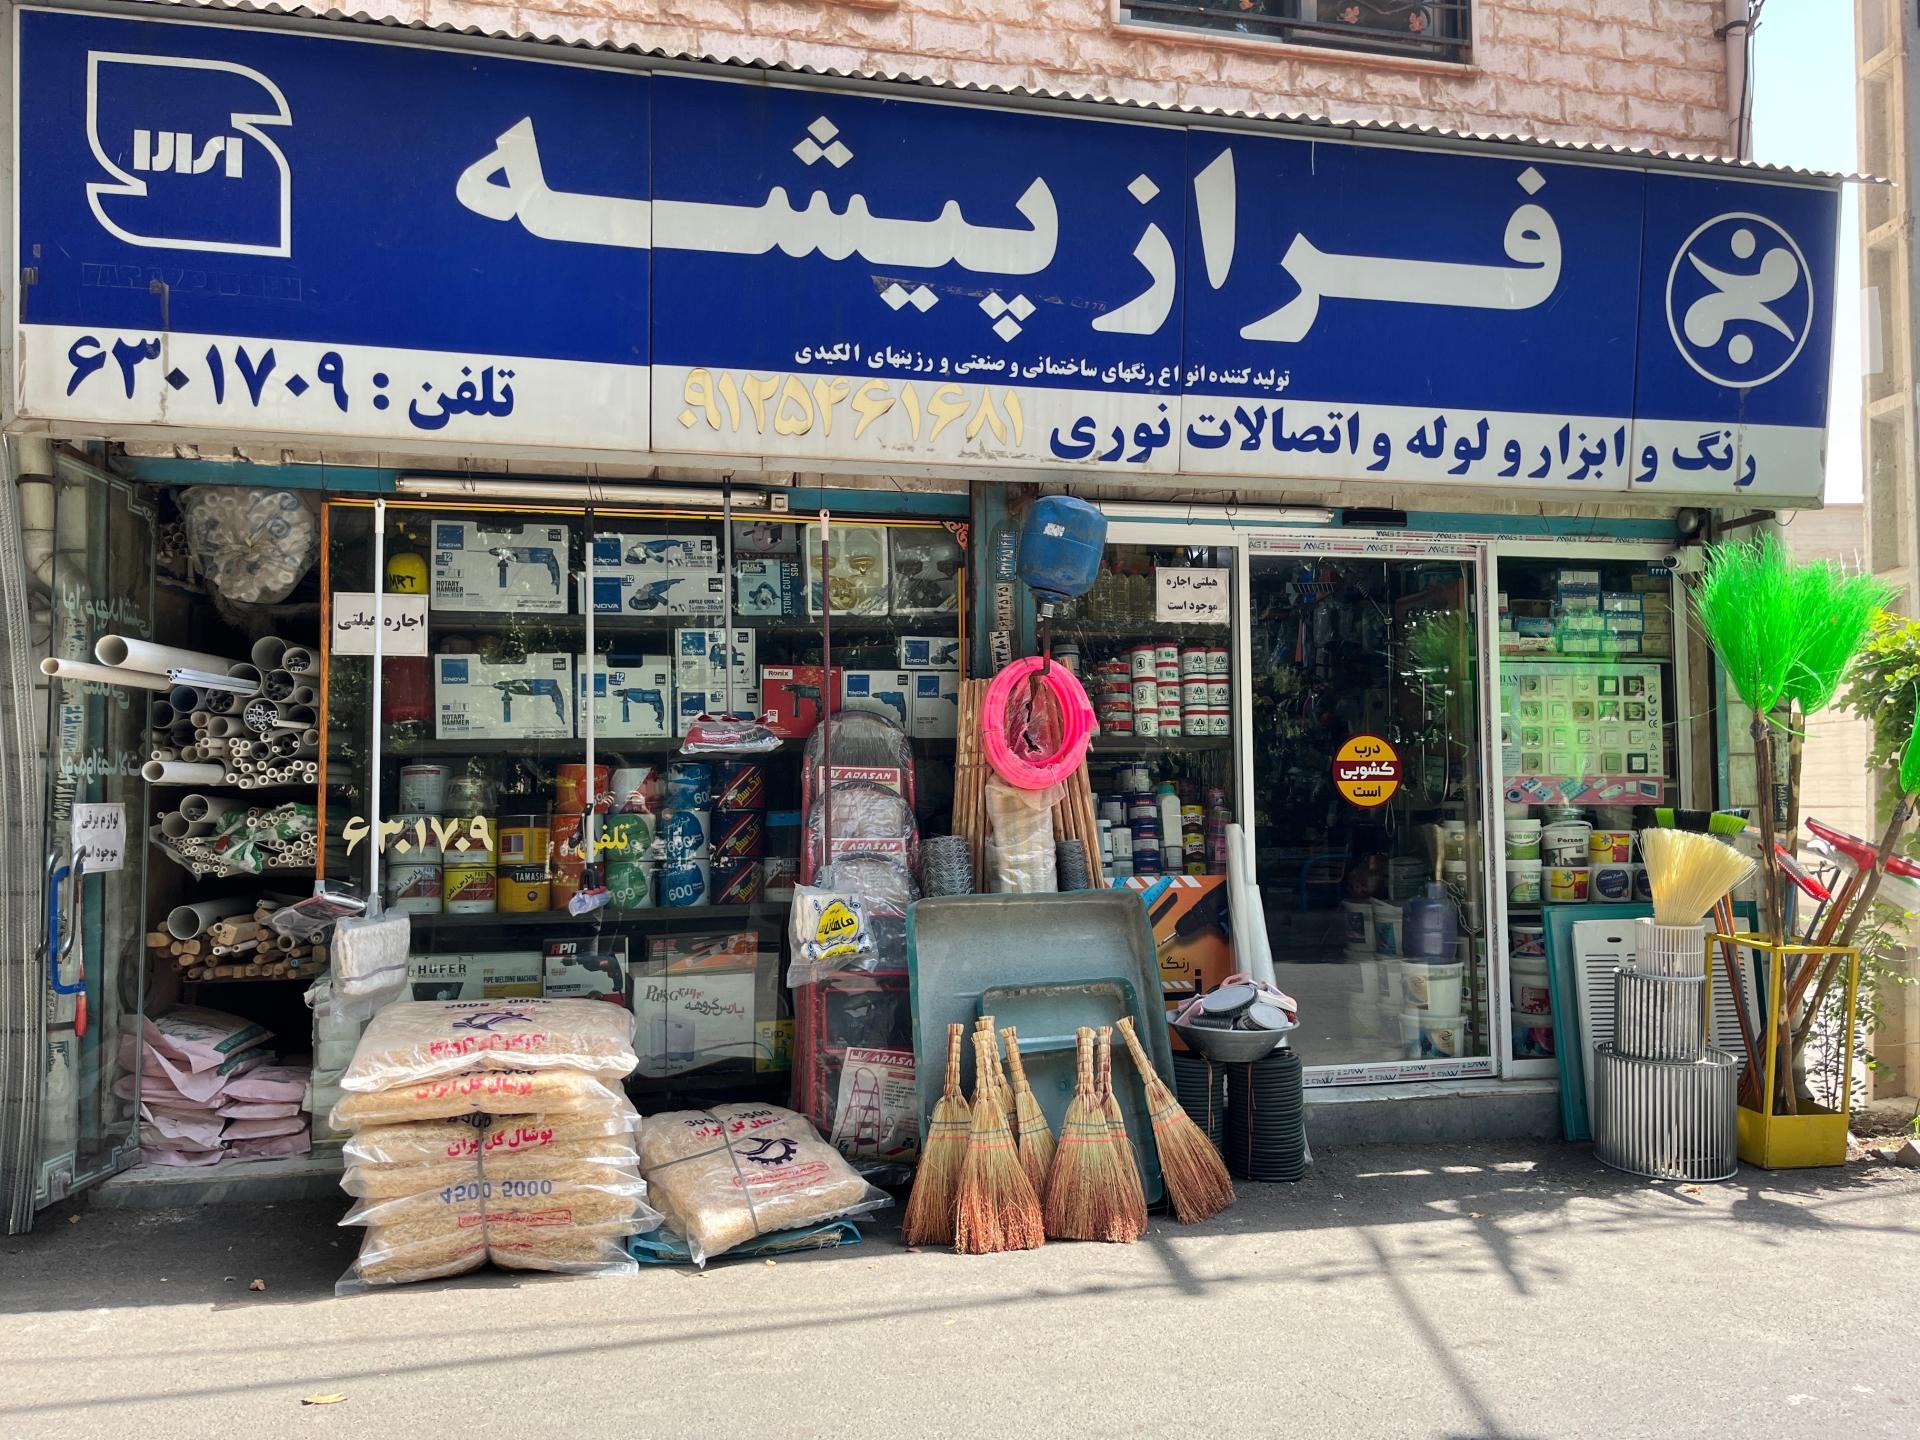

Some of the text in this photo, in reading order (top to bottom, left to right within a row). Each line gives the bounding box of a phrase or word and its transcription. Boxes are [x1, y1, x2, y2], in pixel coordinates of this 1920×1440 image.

[795, 343, 860, 365] الکیدی
[867, 345, 934, 373] رزینهای
[939, 356, 949, 373] و
[954, 354, 1006, 375] صنعتی
[1008, 362, 1019, 378] و
[1022, 356, 1097, 379] ساختمانی
[66, 335, 348, 413] ۶۳۰۱۷۰۹
[1101, 361, 1154, 387] رنگهای
[1209, 367, 1251, 385] کننده
[1253, 368, 1290, 392] تولید
[677, 368, 1024, 448] ۰۹۱۲۵۴۶۱۶۸۱
[1049, 402, 1756, 486] رنگ و ابزار و لوله و اتصالات نوری
[782, 562, 792, 614] STONE CUTTER
[1166, 575, 1218, 589] هیلتی اجاره
[1167, 600, 1218, 613] موجود است
[384, 612, 424, 631] اجاره
[616, 673, 625, 681] 12
[1354, 744, 1381, 758] درب
[1340, 762, 1395, 779] کشویی
[1353, 785, 1381, 797] است
[81, 810, 118, 829] لوازم برقی
[342, 815, 493, 857] ۶۳۰۱۷۰۹
[96, 848, 118, 861] موجود
[612, 887, 636, 903] 199
[668, 884, 694, 902] 600
[418, 964, 467, 974] HUFER
[1161, 955, 1189, 973] رنگ
[872, 1054, 914, 1067] ADASA
[508, 1127, 553, 1148] پوشال
[447, 1137, 479, 1157] یران
